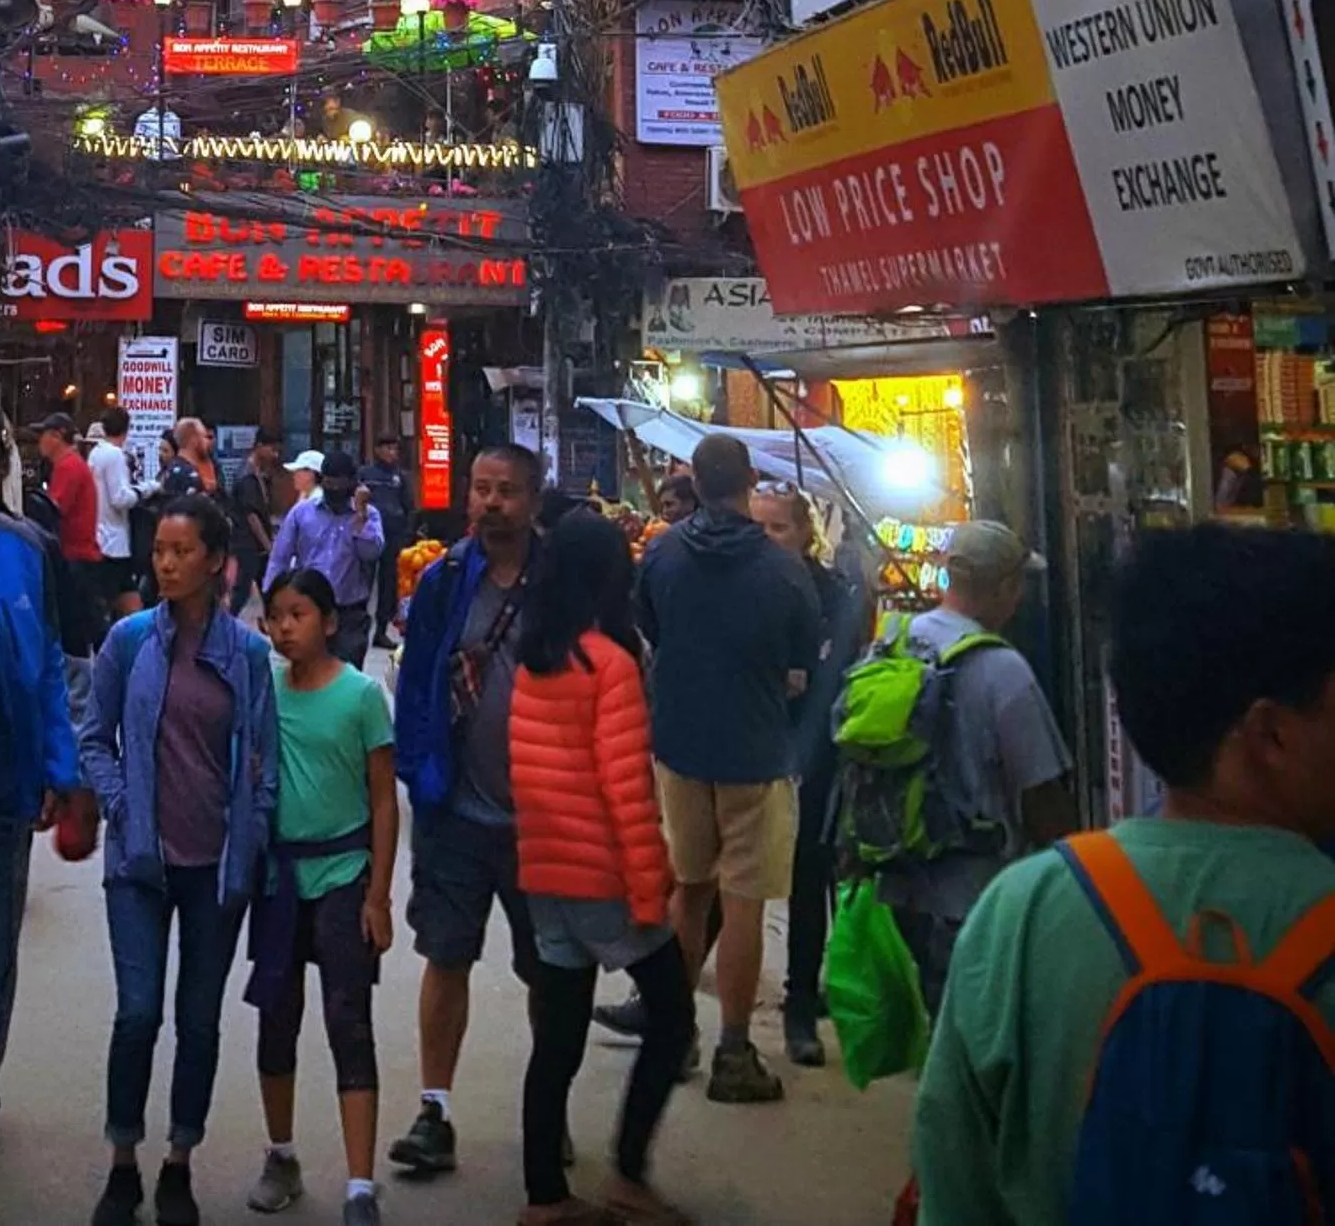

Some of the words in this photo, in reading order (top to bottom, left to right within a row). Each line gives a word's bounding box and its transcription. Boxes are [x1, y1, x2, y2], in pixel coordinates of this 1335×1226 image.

[1047, 3, 1138, 70] WESTERN
[194, 55, 271, 72] TERRACE
[1106, 75, 1185, 133] MONEY
[779, 186, 830, 246] LOW
[836, 162, 915, 233] PRICE
[917, 141, 1006, 219] SHOP
[1112, 153, 1227, 212] EXCHANGE
[2, 241, 139, 300] ads
[158, 250, 248, 282] CAFE
[258, 253, 289, 282] &
[819, 260, 878, 298] THAMEL
[883, 240, 1010, 290] SUPERMARKET
[213, 326, 246, 344] SIM
[123, 360, 173, 373] GOODWILL
[207, 345, 249, 361] CARD
[123, 376, 173, 394] MONEY
[123, 399, 173, 412] EXCHANGE
